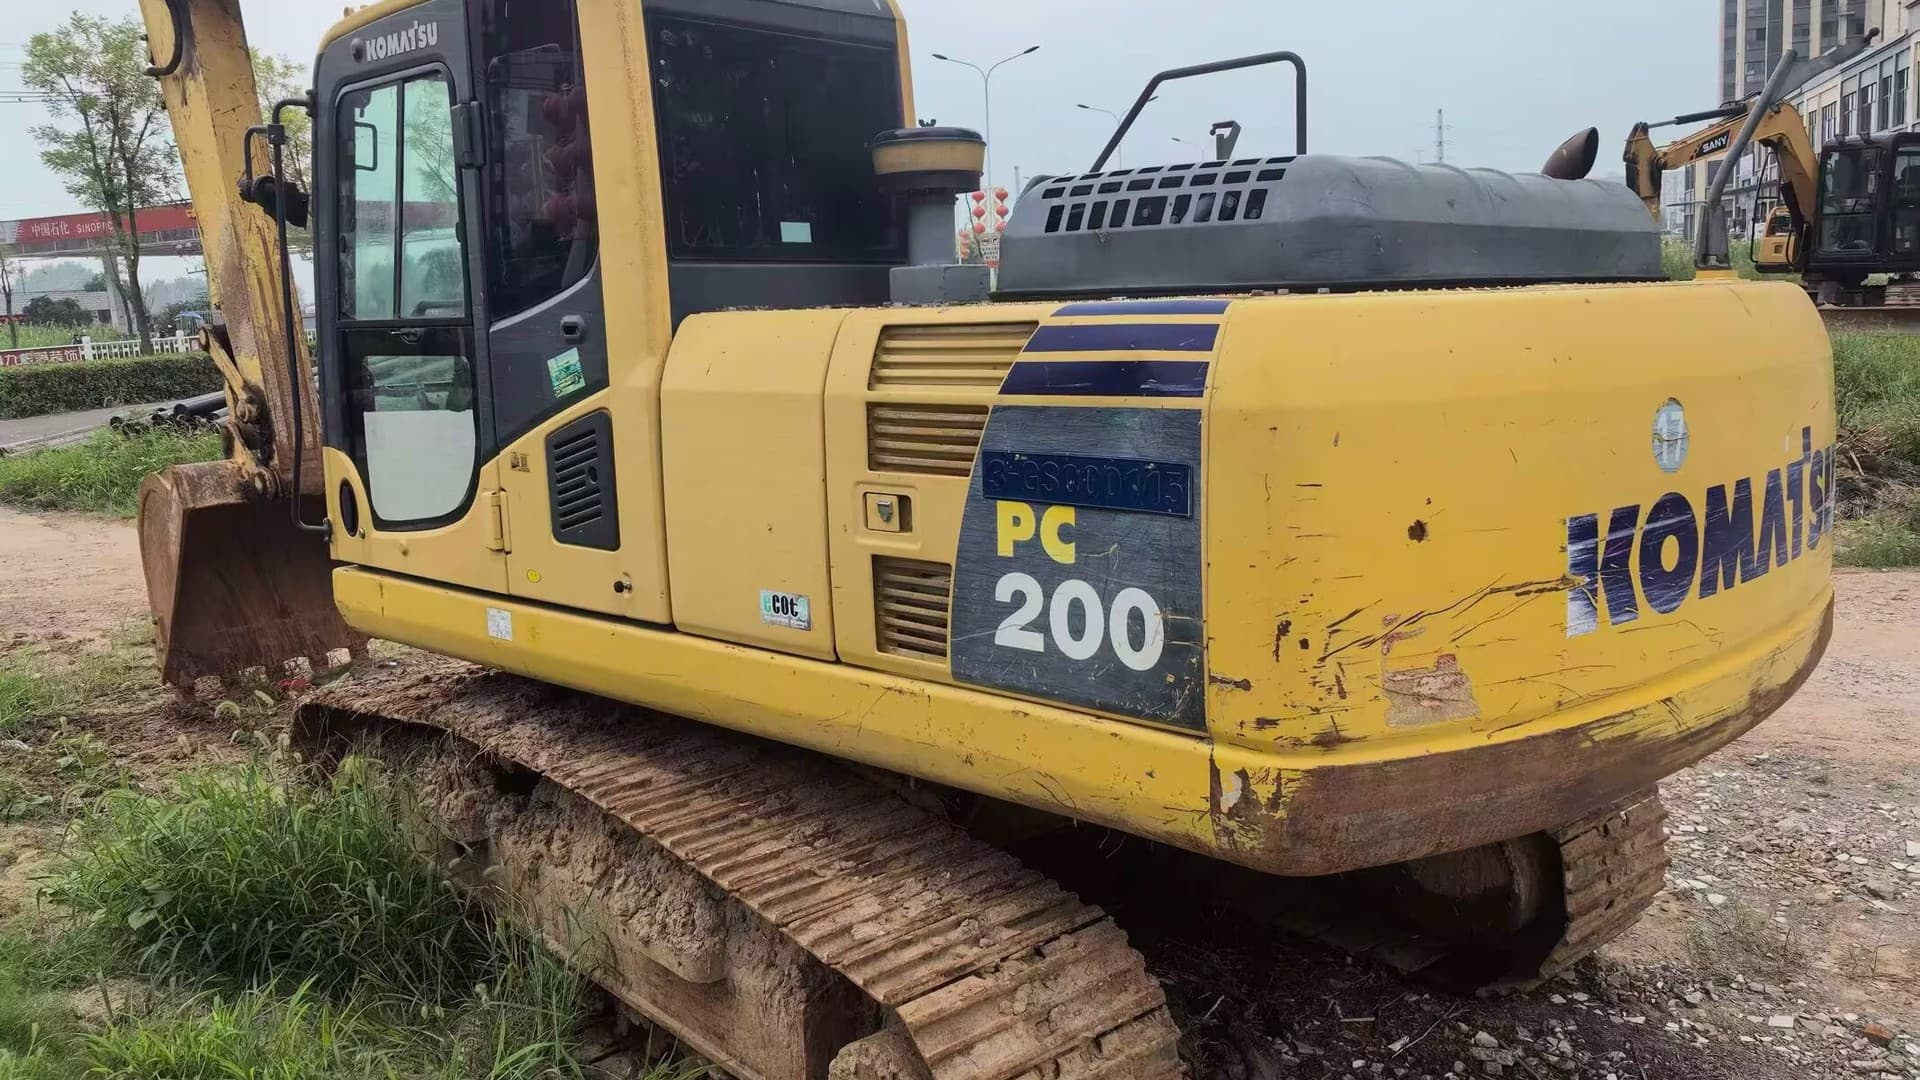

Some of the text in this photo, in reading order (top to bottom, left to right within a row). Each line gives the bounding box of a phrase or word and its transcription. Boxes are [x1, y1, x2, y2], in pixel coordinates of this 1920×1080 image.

[366, 20, 438, 62] KOMATSU
[1702, 135, 1727, 153] SANY
[31, 219, 70, 237] 中国石化
[996, 500, 1076, 564] PC
[1566, 425, 1836, 639] KOMATSU
[994, 572, 1165, 671] 200
